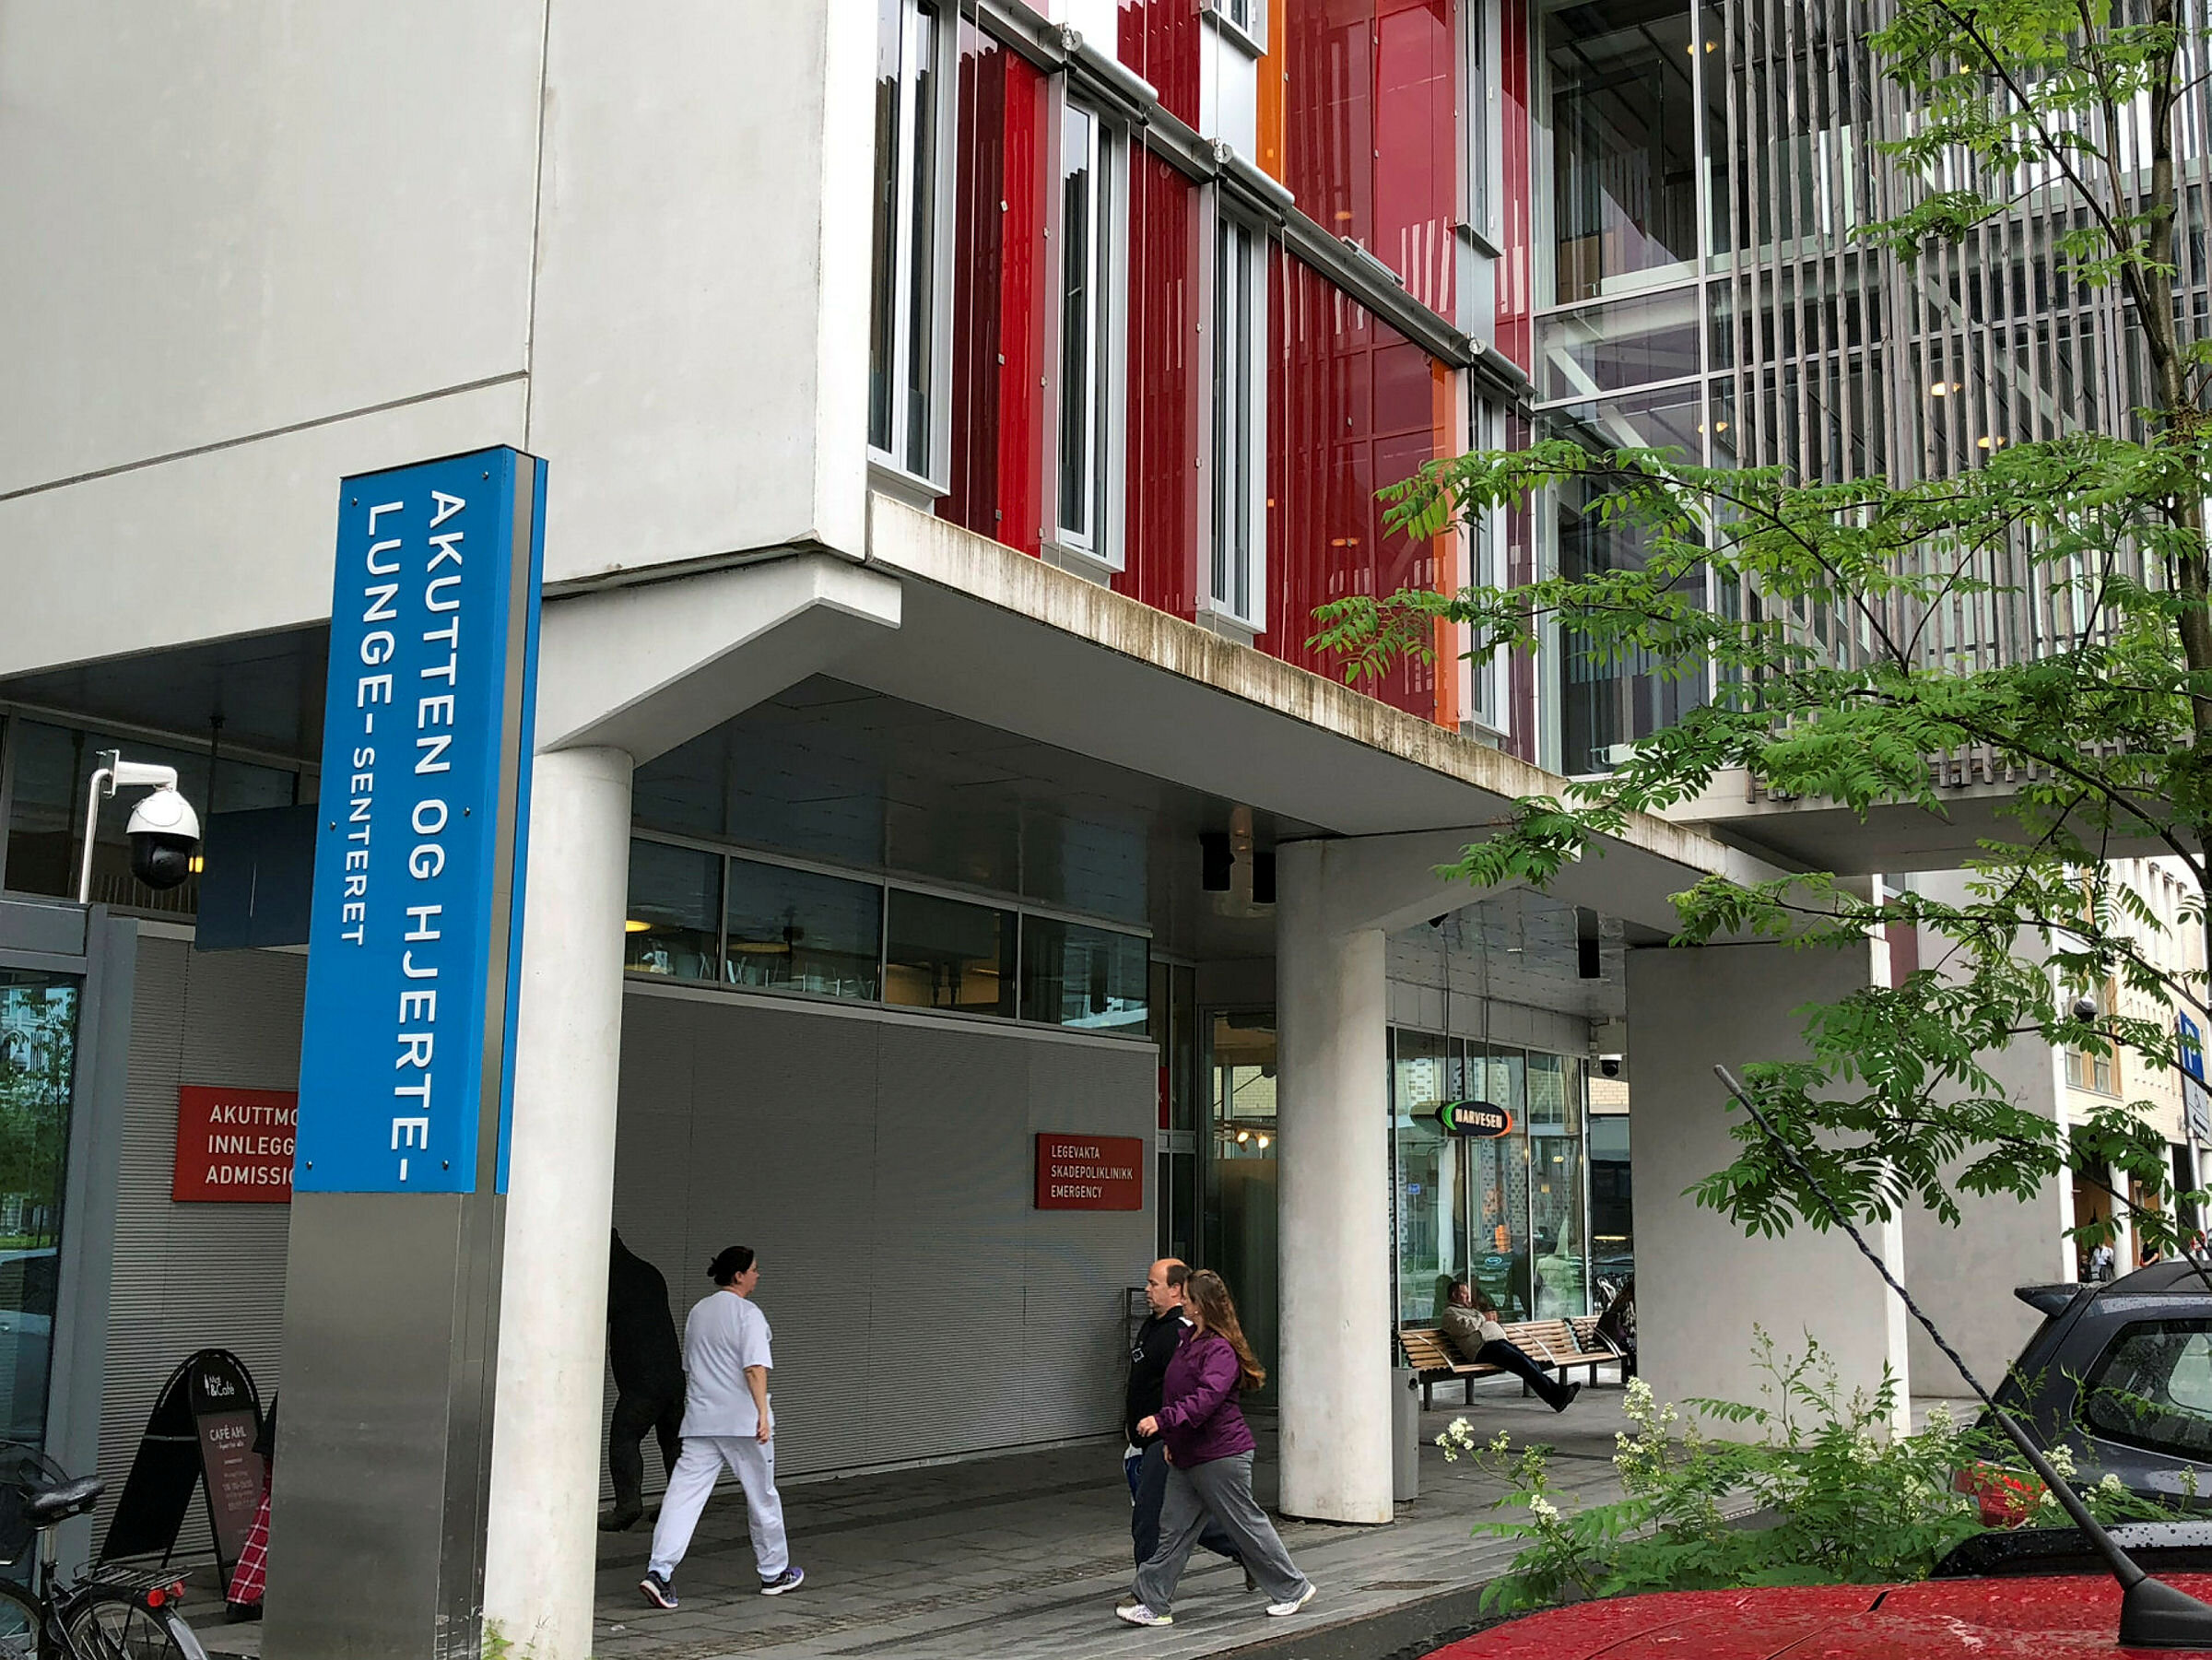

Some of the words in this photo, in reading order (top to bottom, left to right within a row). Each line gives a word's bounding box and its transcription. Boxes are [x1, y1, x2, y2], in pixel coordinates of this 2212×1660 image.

[415, 490, 466, 774] AKUTTEN
[399, 798, 449, 879] OG
[391, 904, 442, 1182] HJERTE-
[1454, 1108, 1503, 1129] NARVESEN
[1051, 1145, 1100, 1160] LEGEVAKTA
[1051, 1165, 1133, 1180] SKADEPOLIKLINIKK
[1051, 1185, 1103, 1199] EMERGENCY
